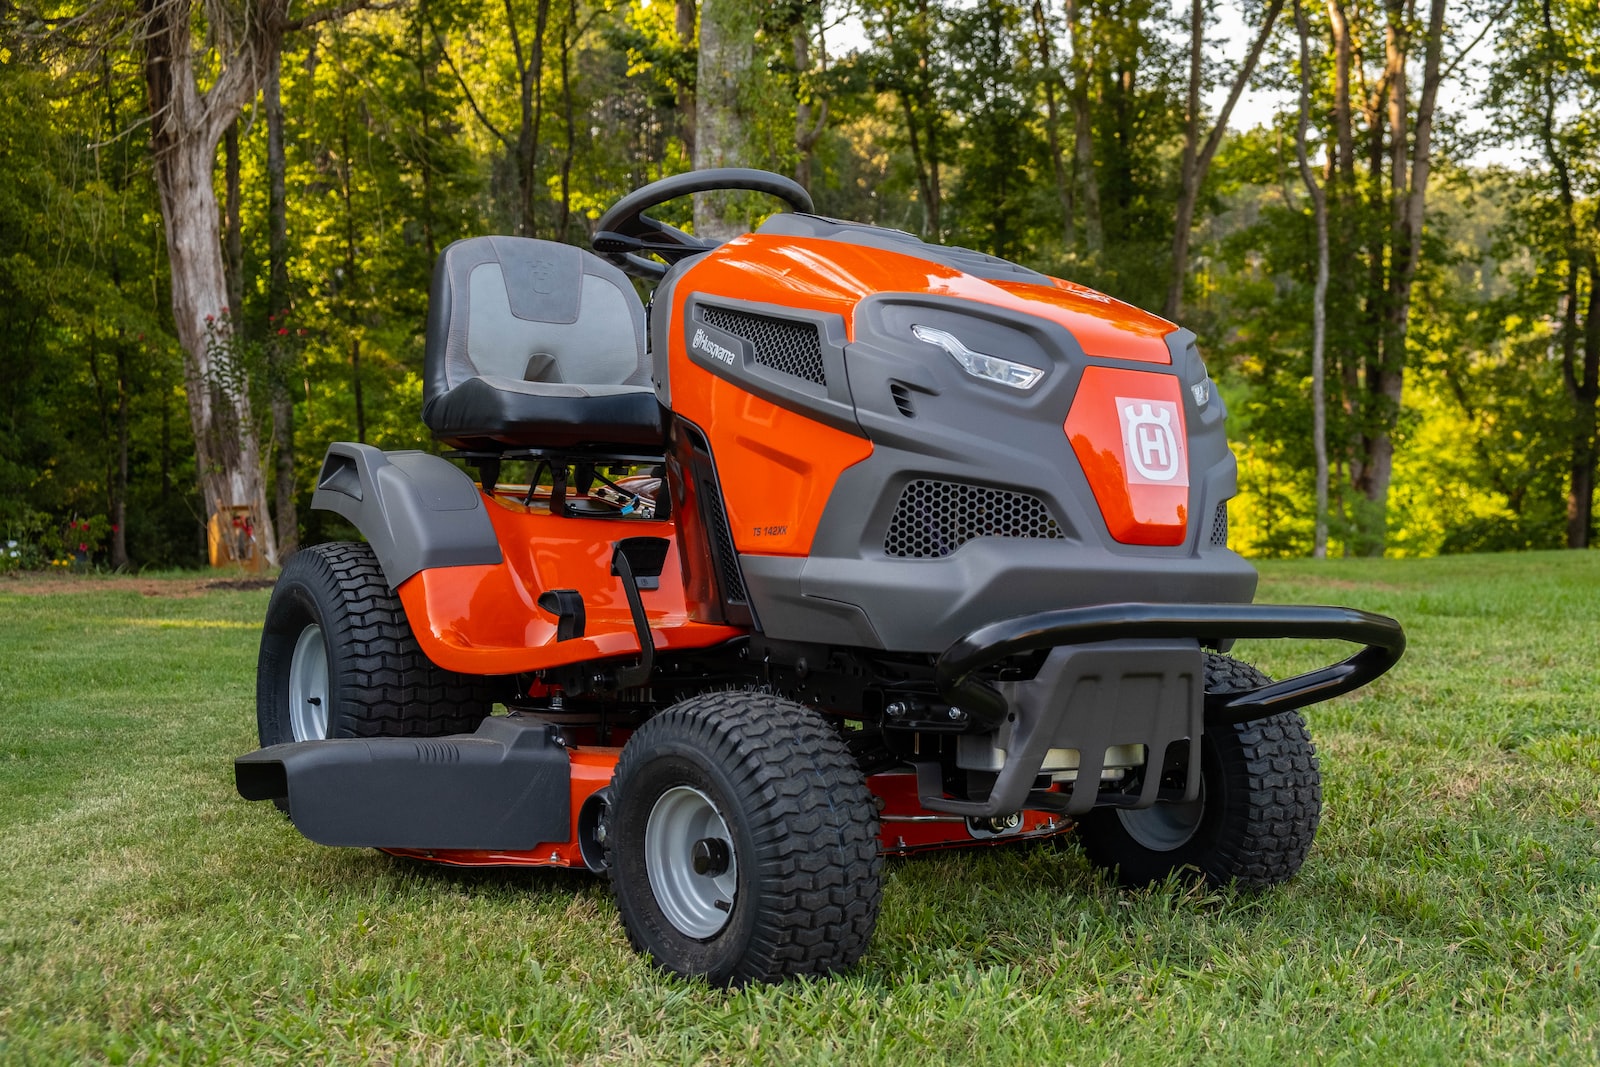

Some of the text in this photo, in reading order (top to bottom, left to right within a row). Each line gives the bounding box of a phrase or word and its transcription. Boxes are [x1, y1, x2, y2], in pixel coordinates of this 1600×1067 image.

[698, 334, 735, 365] Husqvarna
[1139, 427, 1168, 465] H
[753, 527, 761, 536] TS
